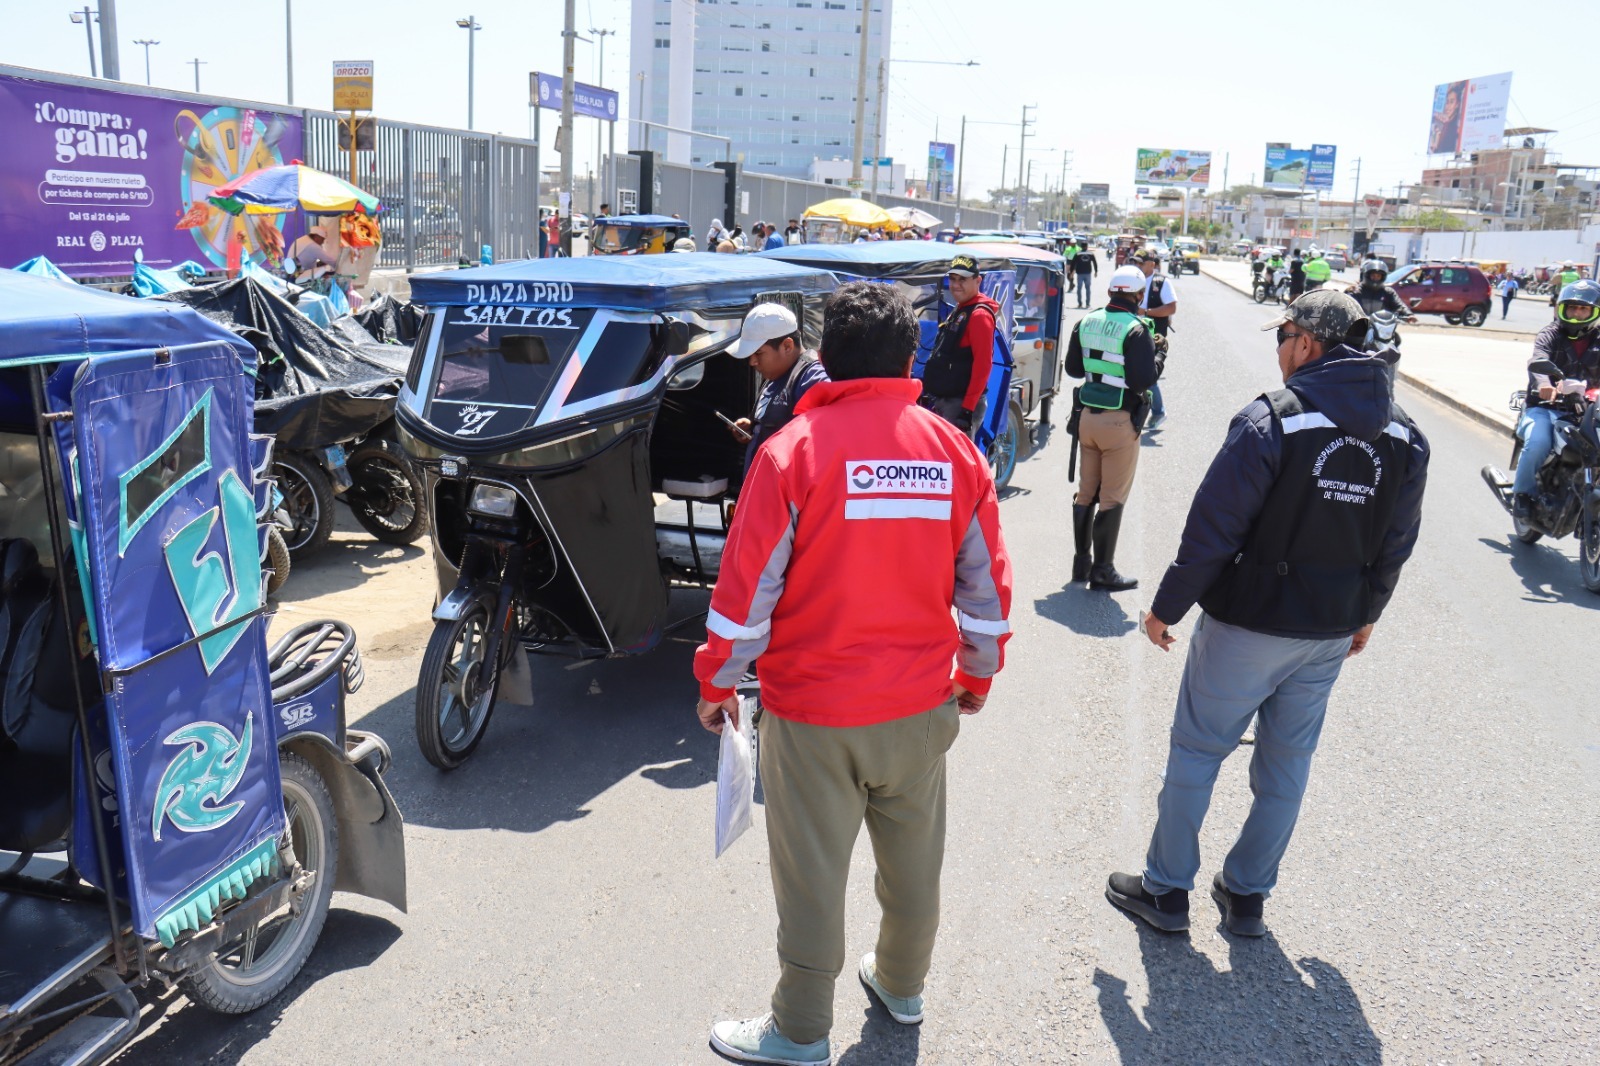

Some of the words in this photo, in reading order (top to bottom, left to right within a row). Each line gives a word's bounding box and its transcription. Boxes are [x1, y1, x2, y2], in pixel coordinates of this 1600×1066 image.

[337, 68, 369, 76] OROZCO
[579, 95, 590, 105] REAL
[589, 97, 604, 108] PLAZA
[35, 101, 124, 132] ¡Compra
[125, 117, 132, 130] y
[55, 127, 148, 163] gana!
[1137, 157, 1160, 169] LOTES
[51, 173, 85, 183] Participa
[95, 177, 120, 185] nuestra
[121, 177, 141, 185] ruleta
[45, 189, 58, 198] por
[58, 188, 83, 198] tickets
[83, 189, 92, 198] de
[93, 191, 119, 200] compra
[120, 191, 129, 200] de
[129, 191, 148, 200] S/100
[69, 212, 81, 220] Del
[90, 212, 98, 221] al
[106, 213, 115, 221] de
[115, 213, 131, 222] julio
[57, 236, 86, 247] REAL
[111, 236, 144, 246] PLAZA
[467, 282, 528, 303] PLAZA
[460, 306, 573, 327] SANTOS
[1312, 437, 1345, 477] MUNICIPALIDAD
[1344, 436, 1377, 458] PROVINCIAL
[876, 465, 948, 482] CONTROL
[877, 480, 947, 490] PARKING
[1317, 479, 1348, 491] INSPECTOR
[1347, 483, 1376, 496] MUNICIPAL
[1323, 491, 1333, 499] DE
[1334, 492, 1367, 504] TRANSPORTE
